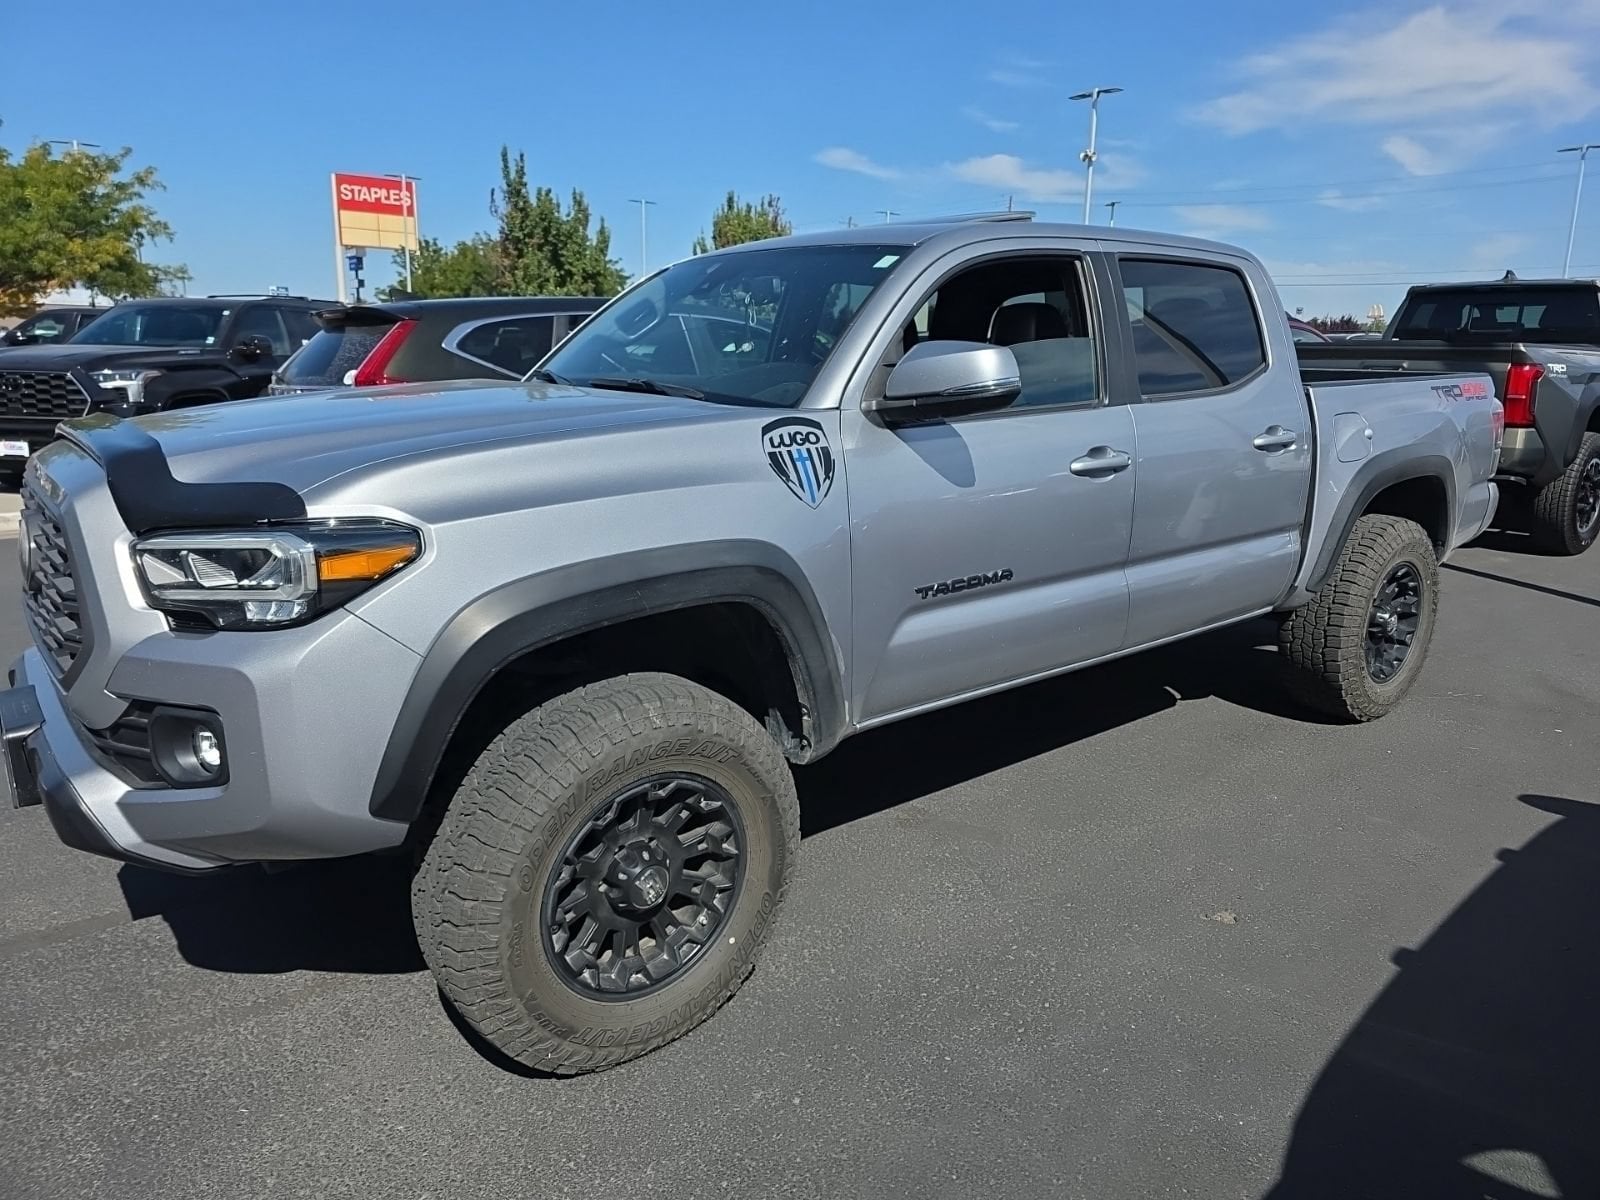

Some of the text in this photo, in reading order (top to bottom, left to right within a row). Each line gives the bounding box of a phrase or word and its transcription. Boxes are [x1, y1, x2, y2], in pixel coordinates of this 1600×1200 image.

[340, 184, 412, 207] STAPLES
[1547, 363, 1567, 373] TRD
[1430, 385, 1463, 402] TRD
[768, 431, 821, 449] LUGO
[914, 568, 1014, 600] TACOMA
[518, 792, 577, 892] OPEN
[584, 740, 692, 801] RANGE
[727, 891, 774, 980] OPEN
[532, 1011, 569, 1040] PLUS
